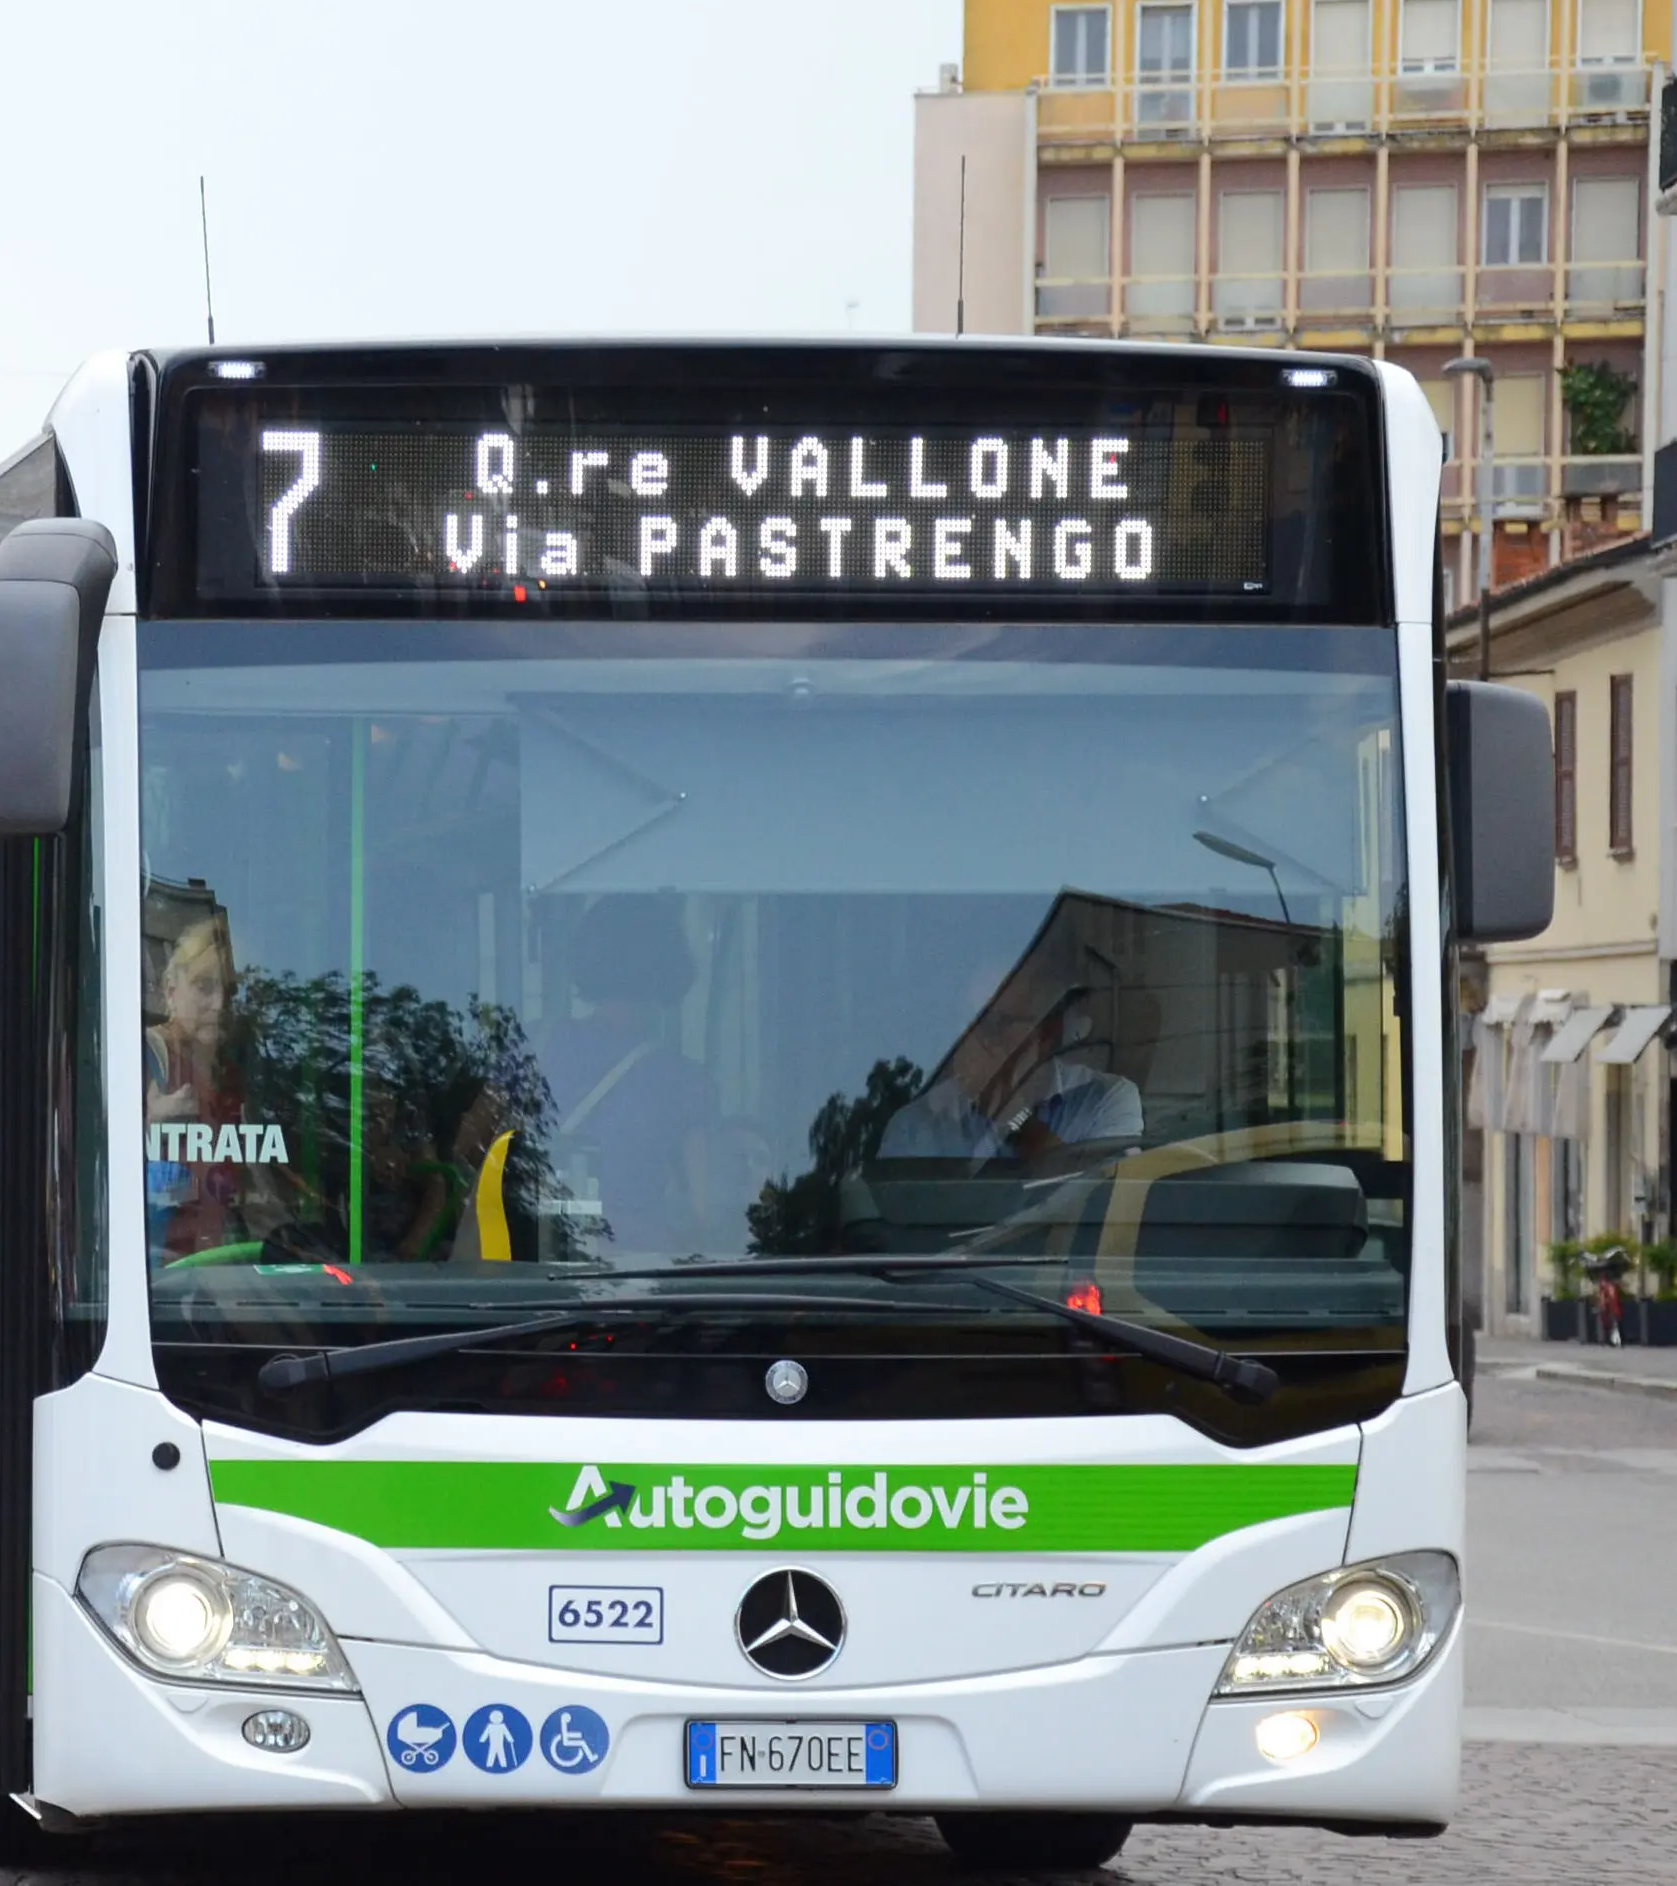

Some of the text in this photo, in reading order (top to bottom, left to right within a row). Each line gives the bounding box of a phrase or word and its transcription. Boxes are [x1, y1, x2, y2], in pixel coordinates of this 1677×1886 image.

[477, 433, 1130, 500] Q.re VALLONE
[262, 431, 320, 573] 7
[445, 513, 1155, 580] Via PASTRENGO
[564, 1465, 1029, 1539] Autoguidovie
[558, 1599, 653, 1628] 6522
[971, 1581, 1106, 1598] CITARO
